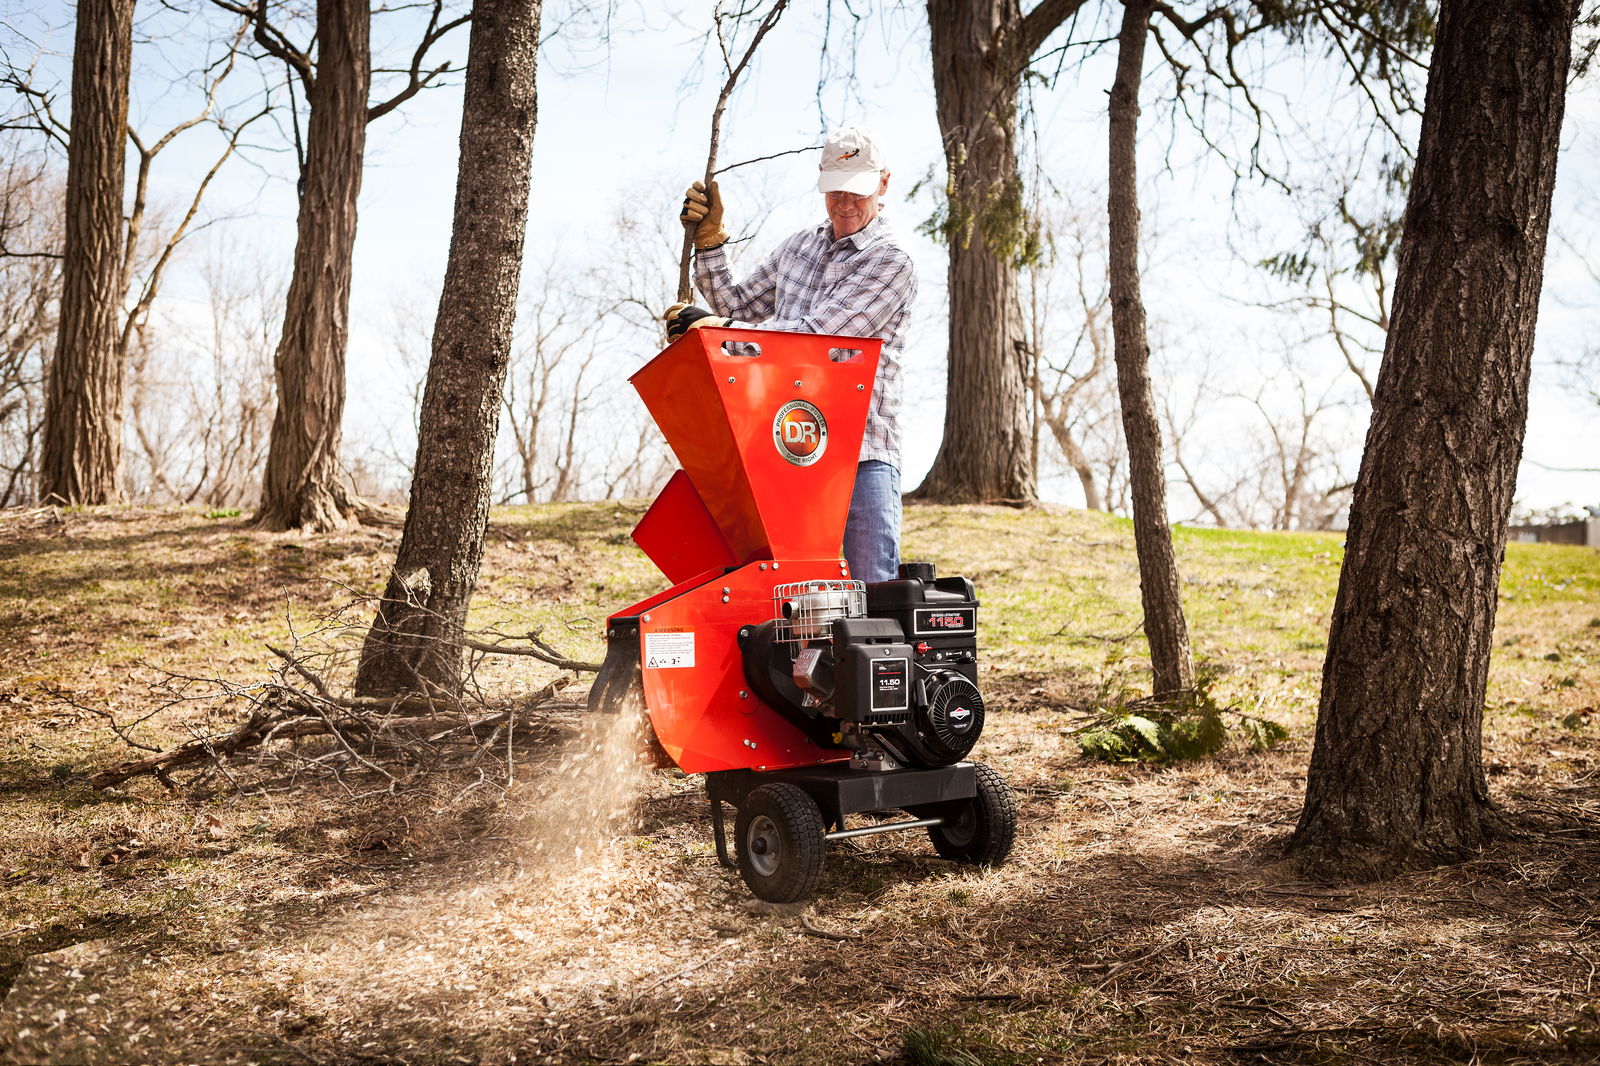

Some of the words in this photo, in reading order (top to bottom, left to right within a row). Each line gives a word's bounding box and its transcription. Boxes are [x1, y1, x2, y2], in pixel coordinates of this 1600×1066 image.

[776, 402, 808, 427] PROFESSIONAL
[810, 407, 825, 428] POWER
[785, 421, 816, 443] DR
[786, 453, 801, 463] DONE
[802, 453, 817, 463] RIGHT
[929, 616, 964, 627] 1150
